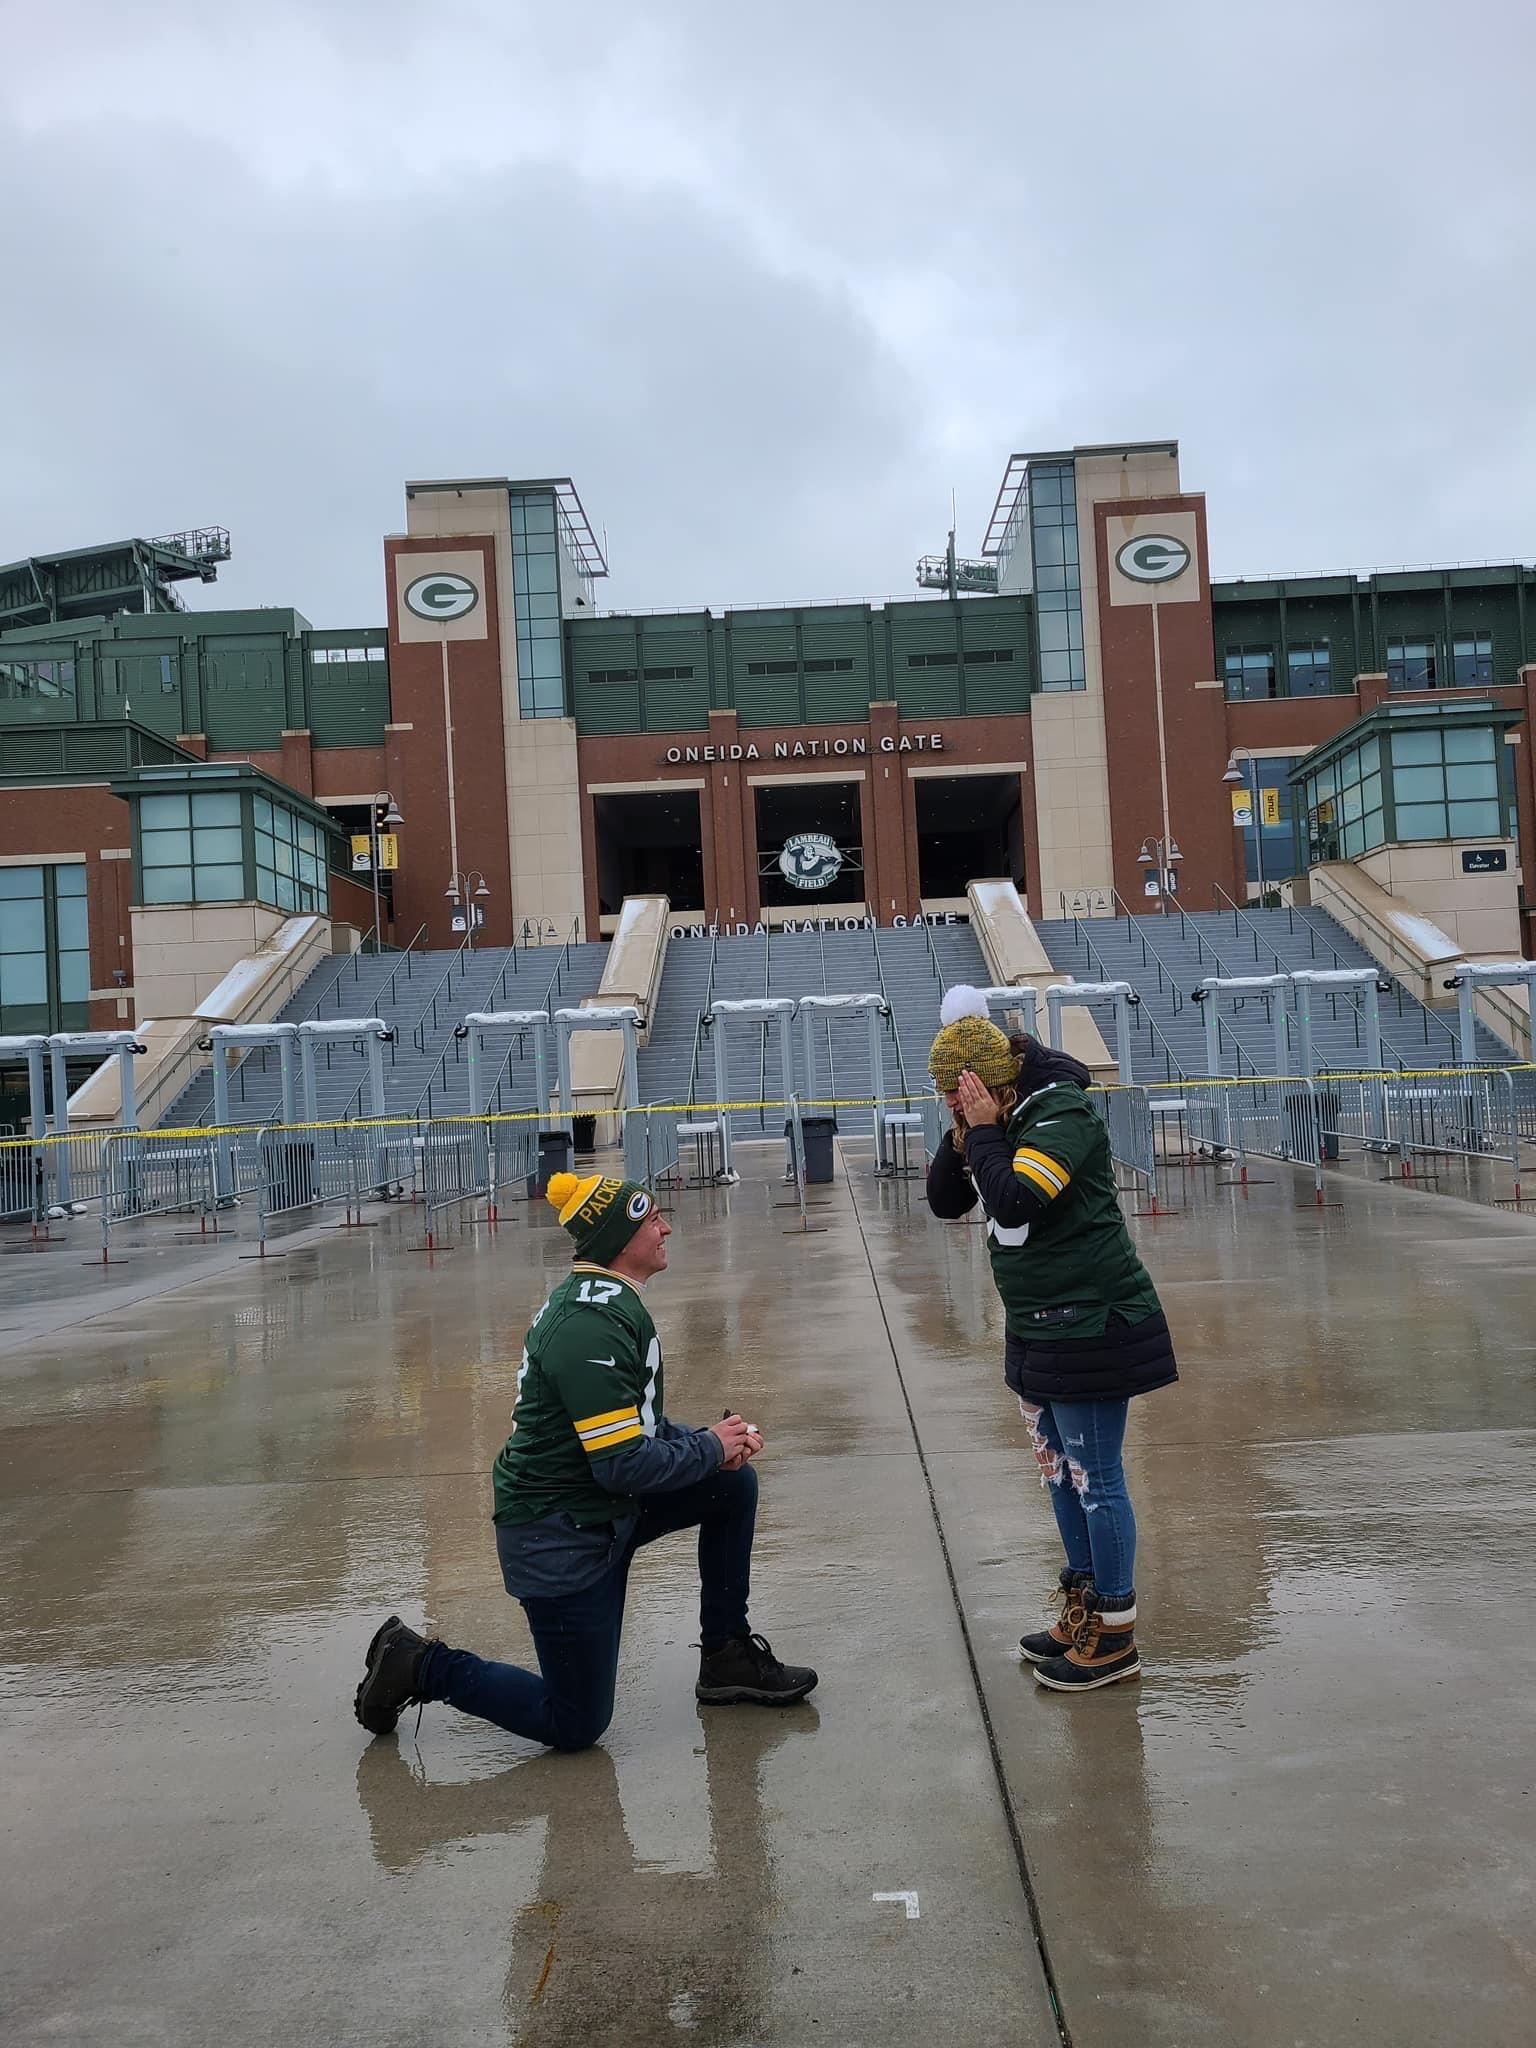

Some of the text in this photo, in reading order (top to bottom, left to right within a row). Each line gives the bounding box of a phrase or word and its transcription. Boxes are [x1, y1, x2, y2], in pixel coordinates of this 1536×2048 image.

[1117, 535, 1189, 581] G
[406, 574, 476, 619] G
[667, 734, 943, 762] ONEIDA NATION GATE
[1268, 795, 1276, 818] TOUR
[788, 834, 831, 848] LAMBEAU
[798, 879, 825, 888] FIELD
[670, 912, 958, 939] ONEIDA NATION GATE
[579, 1177, 623, 1225] PACKE
